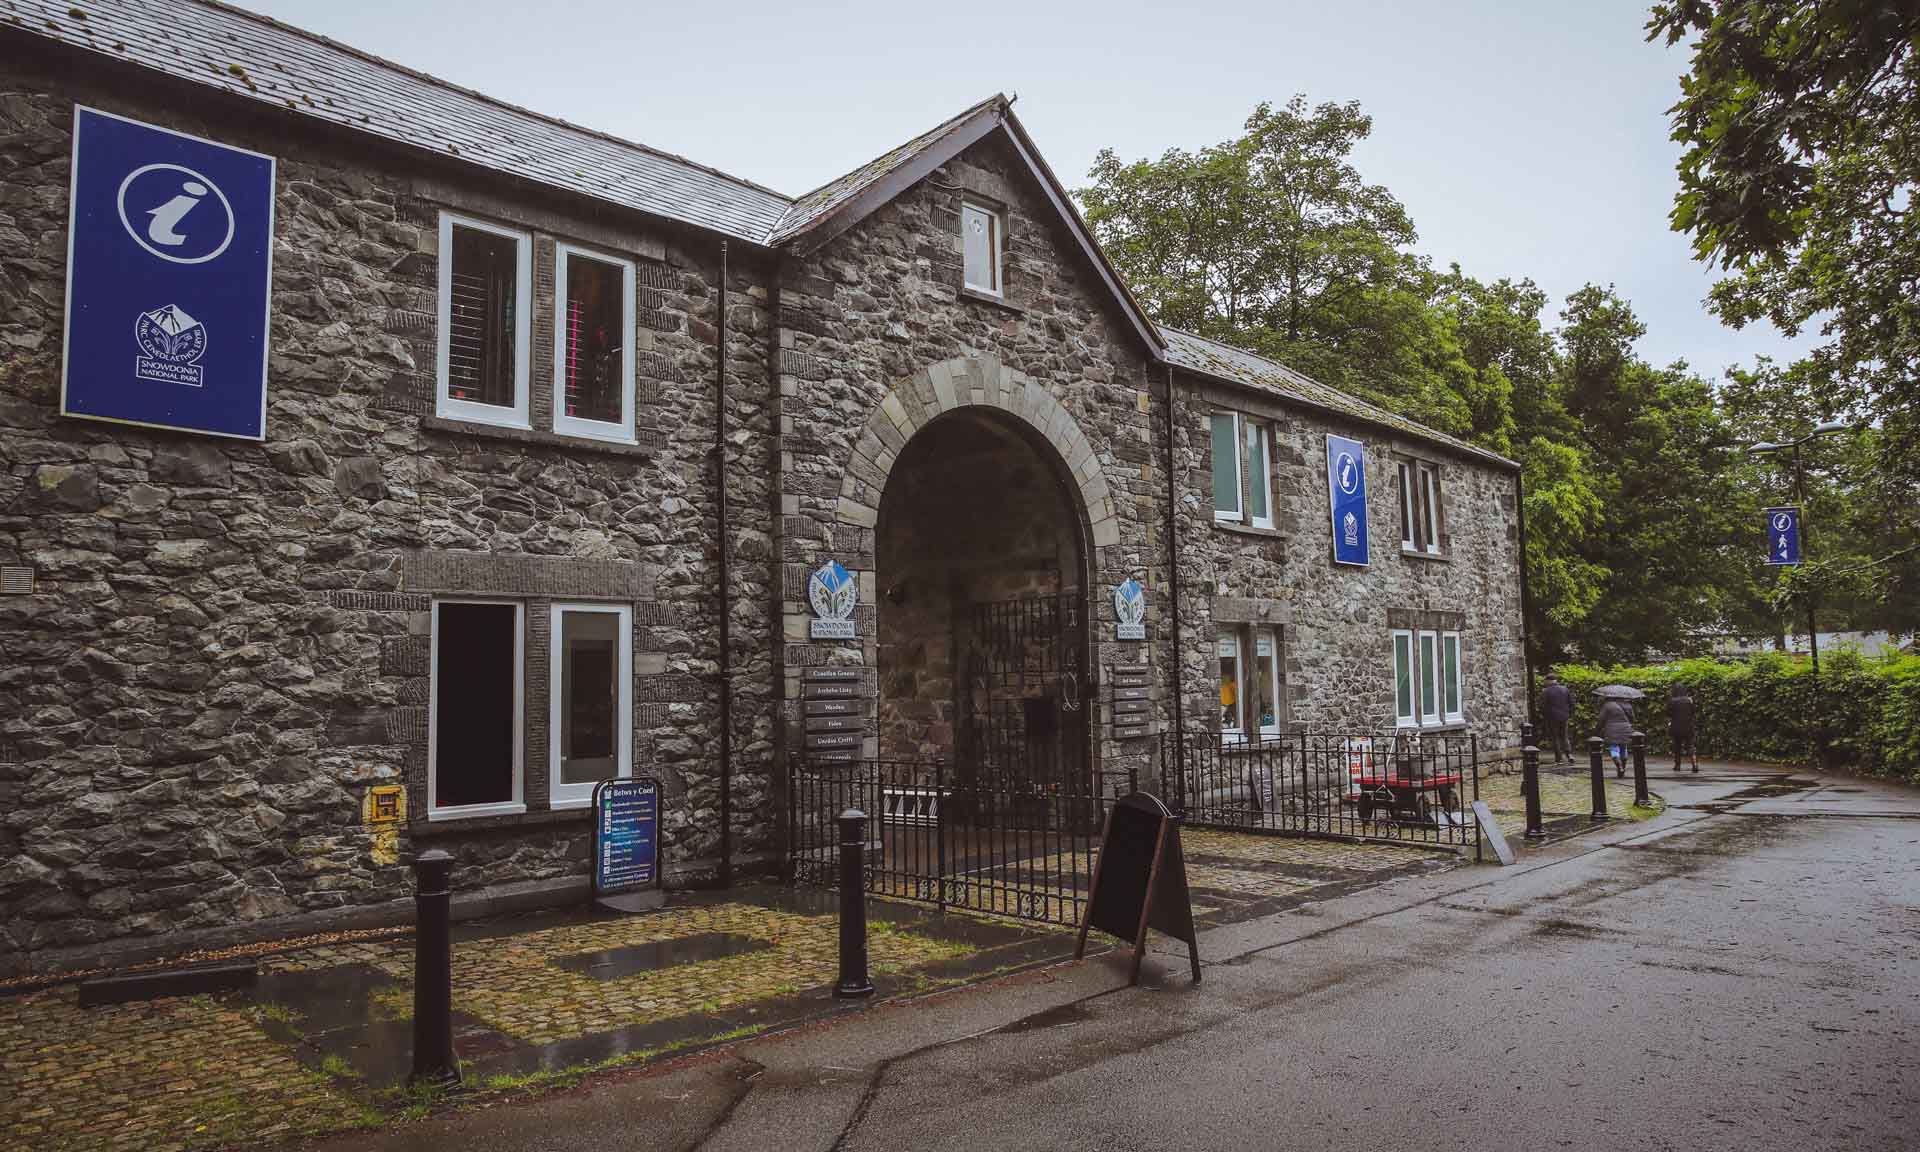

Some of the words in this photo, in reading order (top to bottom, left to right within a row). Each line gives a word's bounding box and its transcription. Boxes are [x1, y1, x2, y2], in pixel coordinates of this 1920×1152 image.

[141, 360, 199, 376] SNOWDONIA
[141, 368, 178, 380] NATIONAL
[180, 374, 199, 383] PARK
